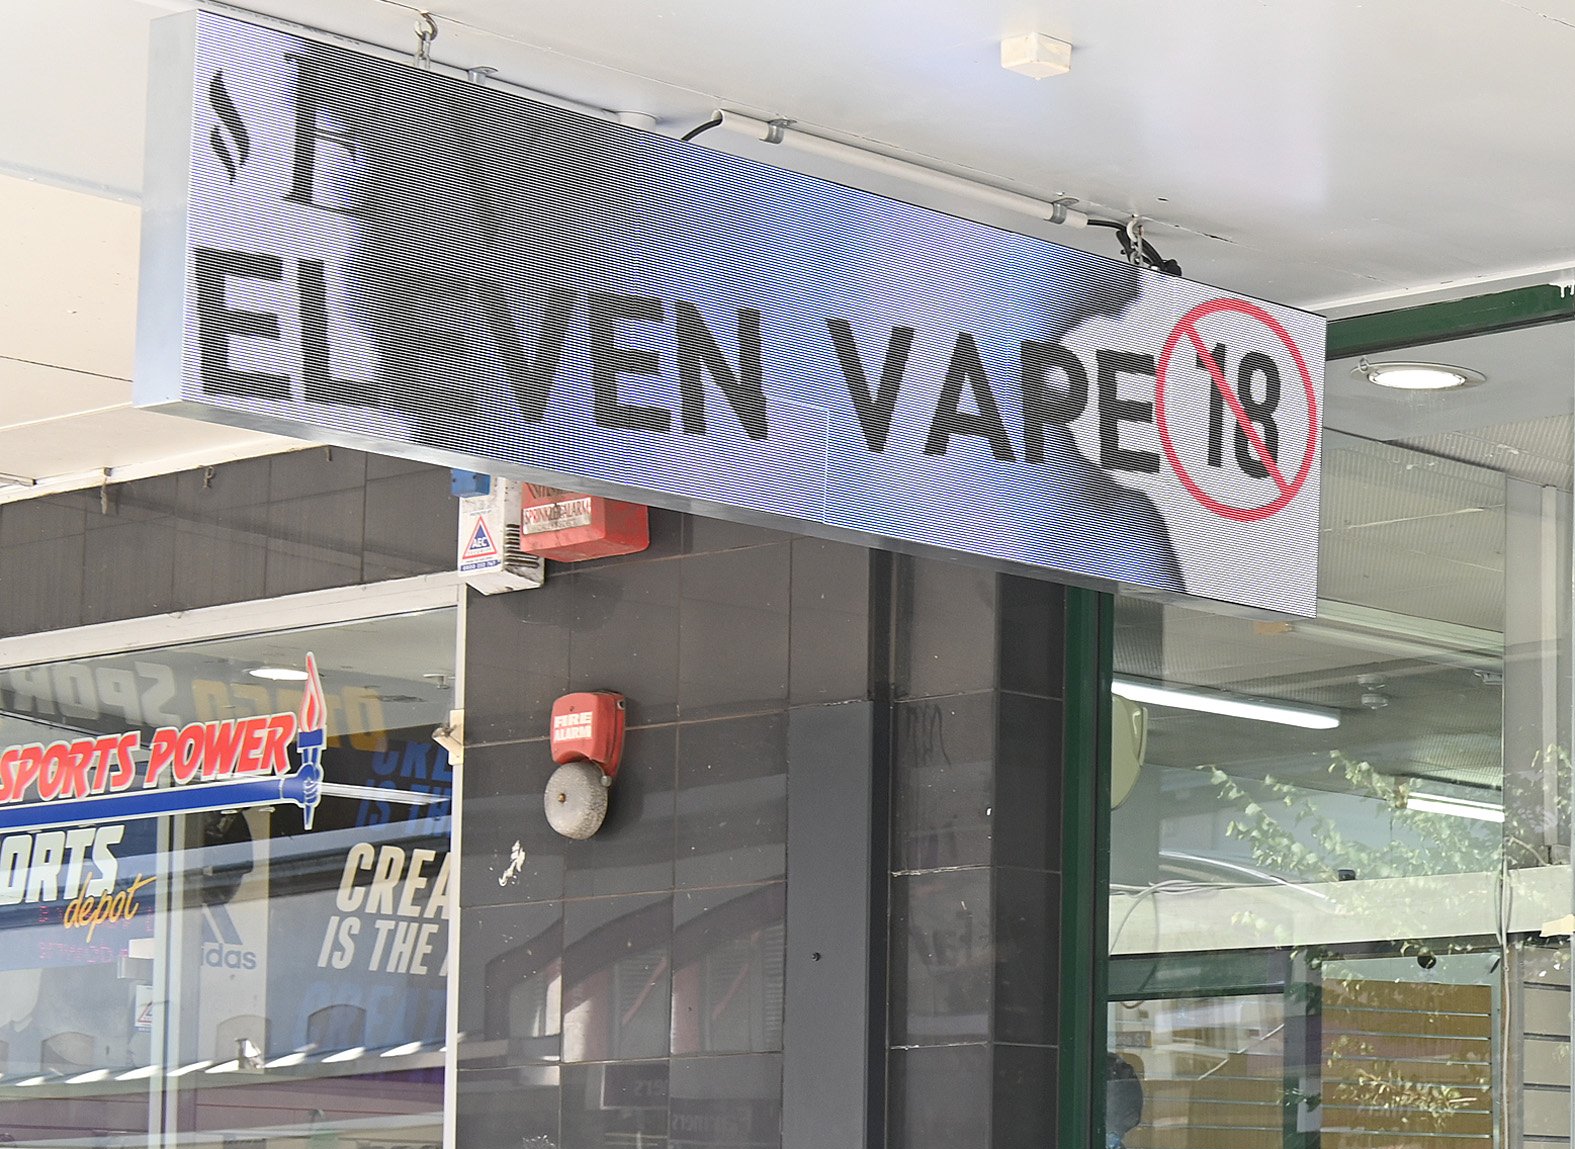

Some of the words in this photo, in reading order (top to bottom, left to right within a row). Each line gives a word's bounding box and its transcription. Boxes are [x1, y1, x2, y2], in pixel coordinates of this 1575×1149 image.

[194, 245, 769, 441] ELEVEN
[825, 317, 1160, 474] VAPE
[1195, 342, 1282, 480] 18
[0, 731, 141, 803] SPORTS
[143, 711, 298, 789] POWER
[554, 712, 593, 729] FIRE
[555, 725, 593, 742] ALARM
[0, 825, 125, 906] ORTS
[64, 872, 157, 944] depot
[317, 915, 361, 970] IS
[368, 920, 439, 976] THE
